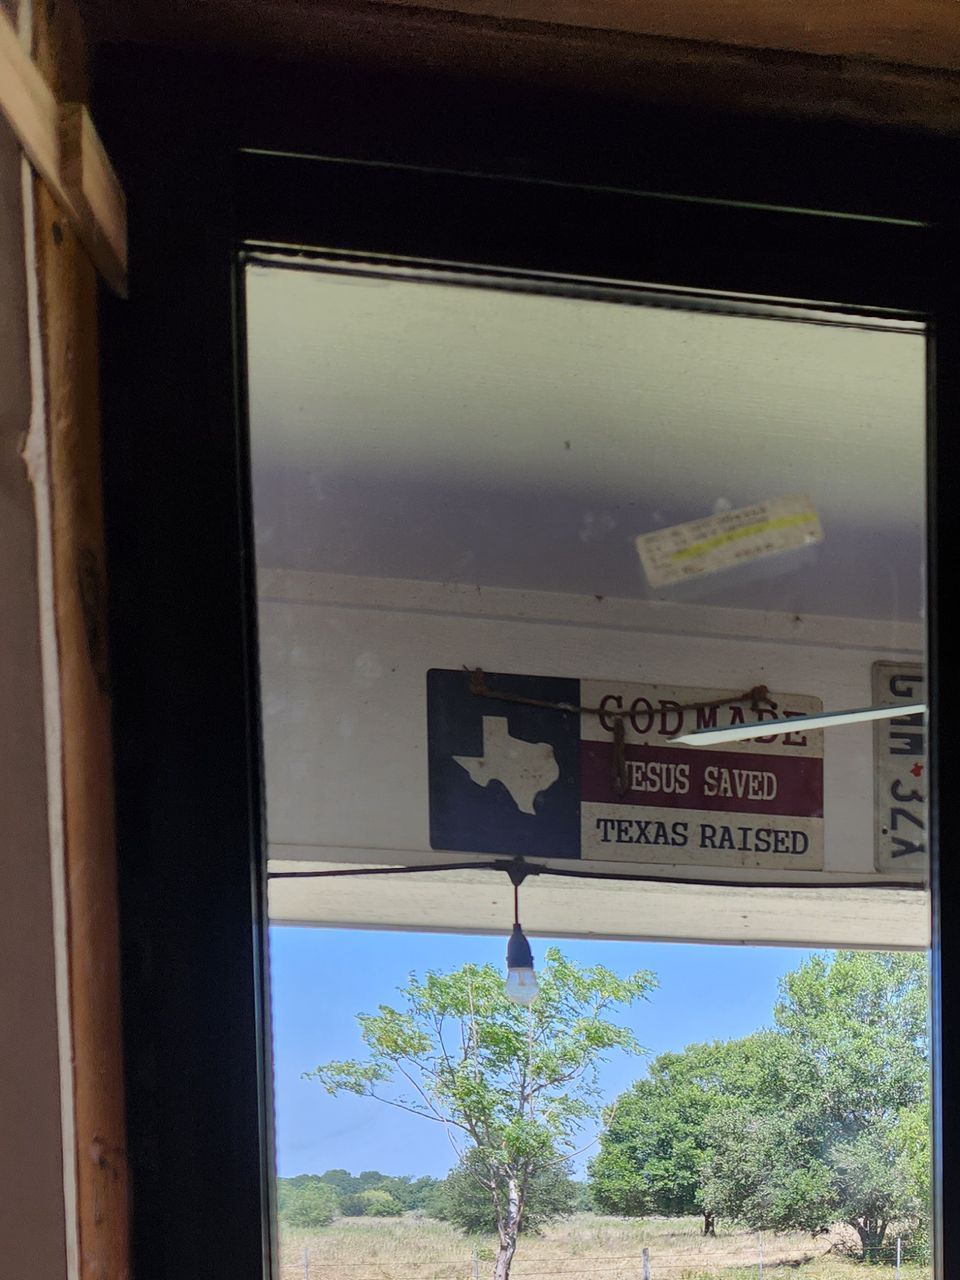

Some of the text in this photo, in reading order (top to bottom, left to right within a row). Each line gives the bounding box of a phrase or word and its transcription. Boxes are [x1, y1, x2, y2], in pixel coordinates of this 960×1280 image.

[599, 694, 807, 747] GOD MADE
[704, 766, 778, 800] SAVED
[596, 818, 809, 855] TEXAS RAISED
